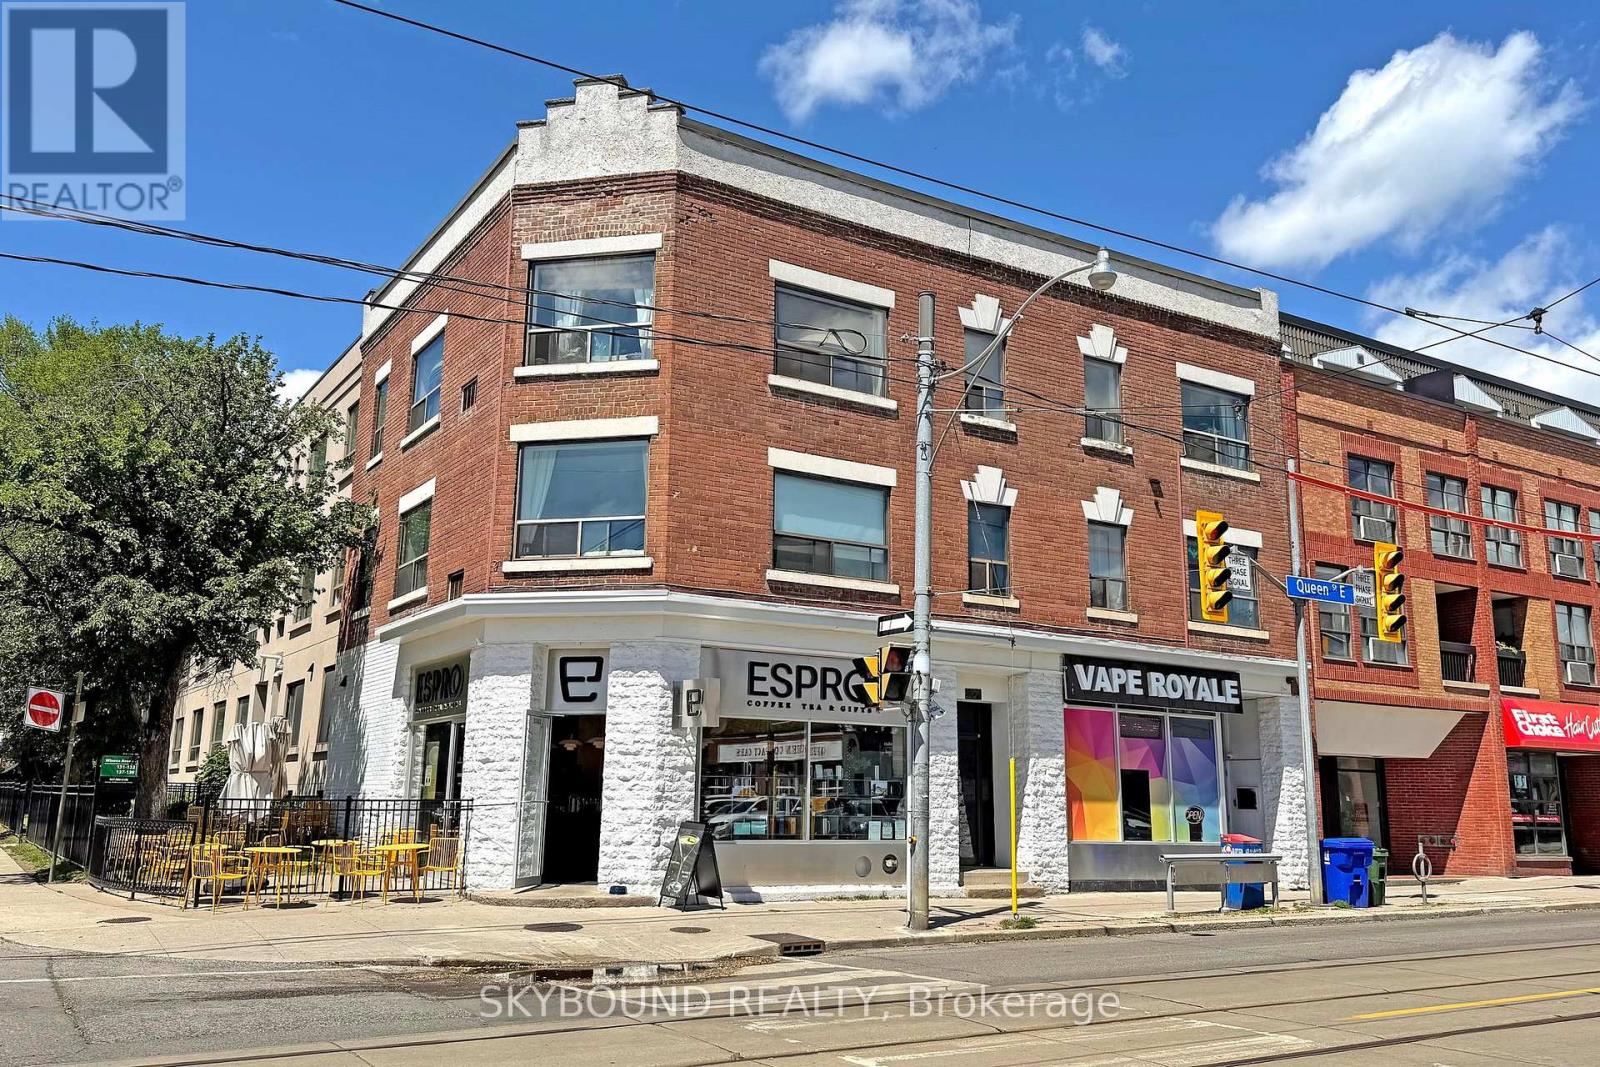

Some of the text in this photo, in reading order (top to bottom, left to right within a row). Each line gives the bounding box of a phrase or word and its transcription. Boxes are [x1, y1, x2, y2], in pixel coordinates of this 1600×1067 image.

[1355, 573, 1371, 584] THREE
[1296, 579, 1329, 596] Queen
[1339, 585, 1346, 599] E
[1355, 584, 1372, 594] PHASE
[416, 664, 463, 703] ESPRO
[1073, 664, 1241, 705] VAPE ROYALE
[746, 700, 791, 709] COFFEE
[801, 703, 822, 711] TEA
[1511, 708, 1560, 724] First
[1518, 721, 1567, 737] Choice
